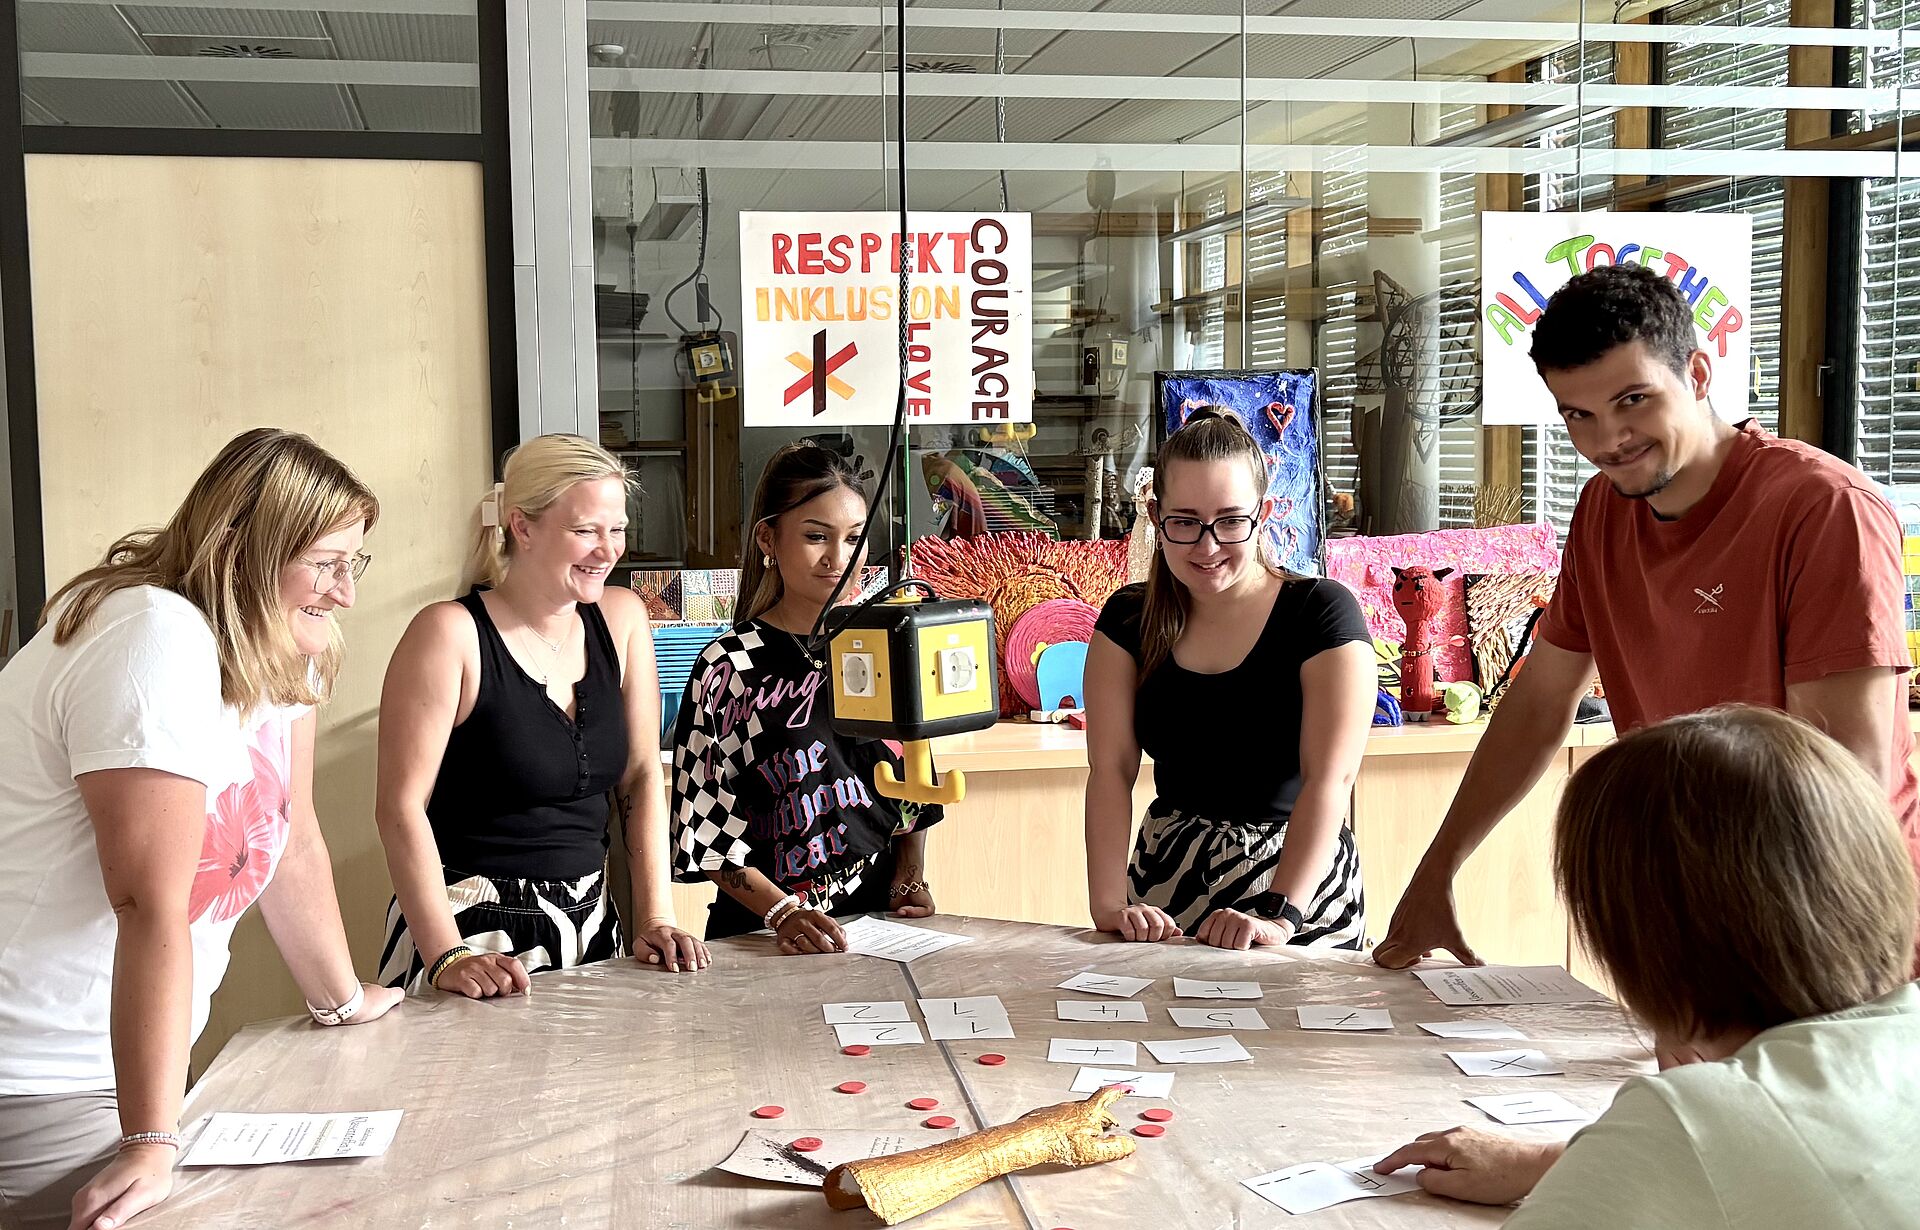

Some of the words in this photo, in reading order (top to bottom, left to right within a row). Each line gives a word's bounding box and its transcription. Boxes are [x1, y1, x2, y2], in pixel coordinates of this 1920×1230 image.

[772, 232, 970, 274] RESPEKT
[755, 285, 961, 322] INKLUSON
[971, 218, 1009, 420] COURAGE
[1486, 271, 1552, 345] ALL
[906, 322, 931, 416] LOVE
